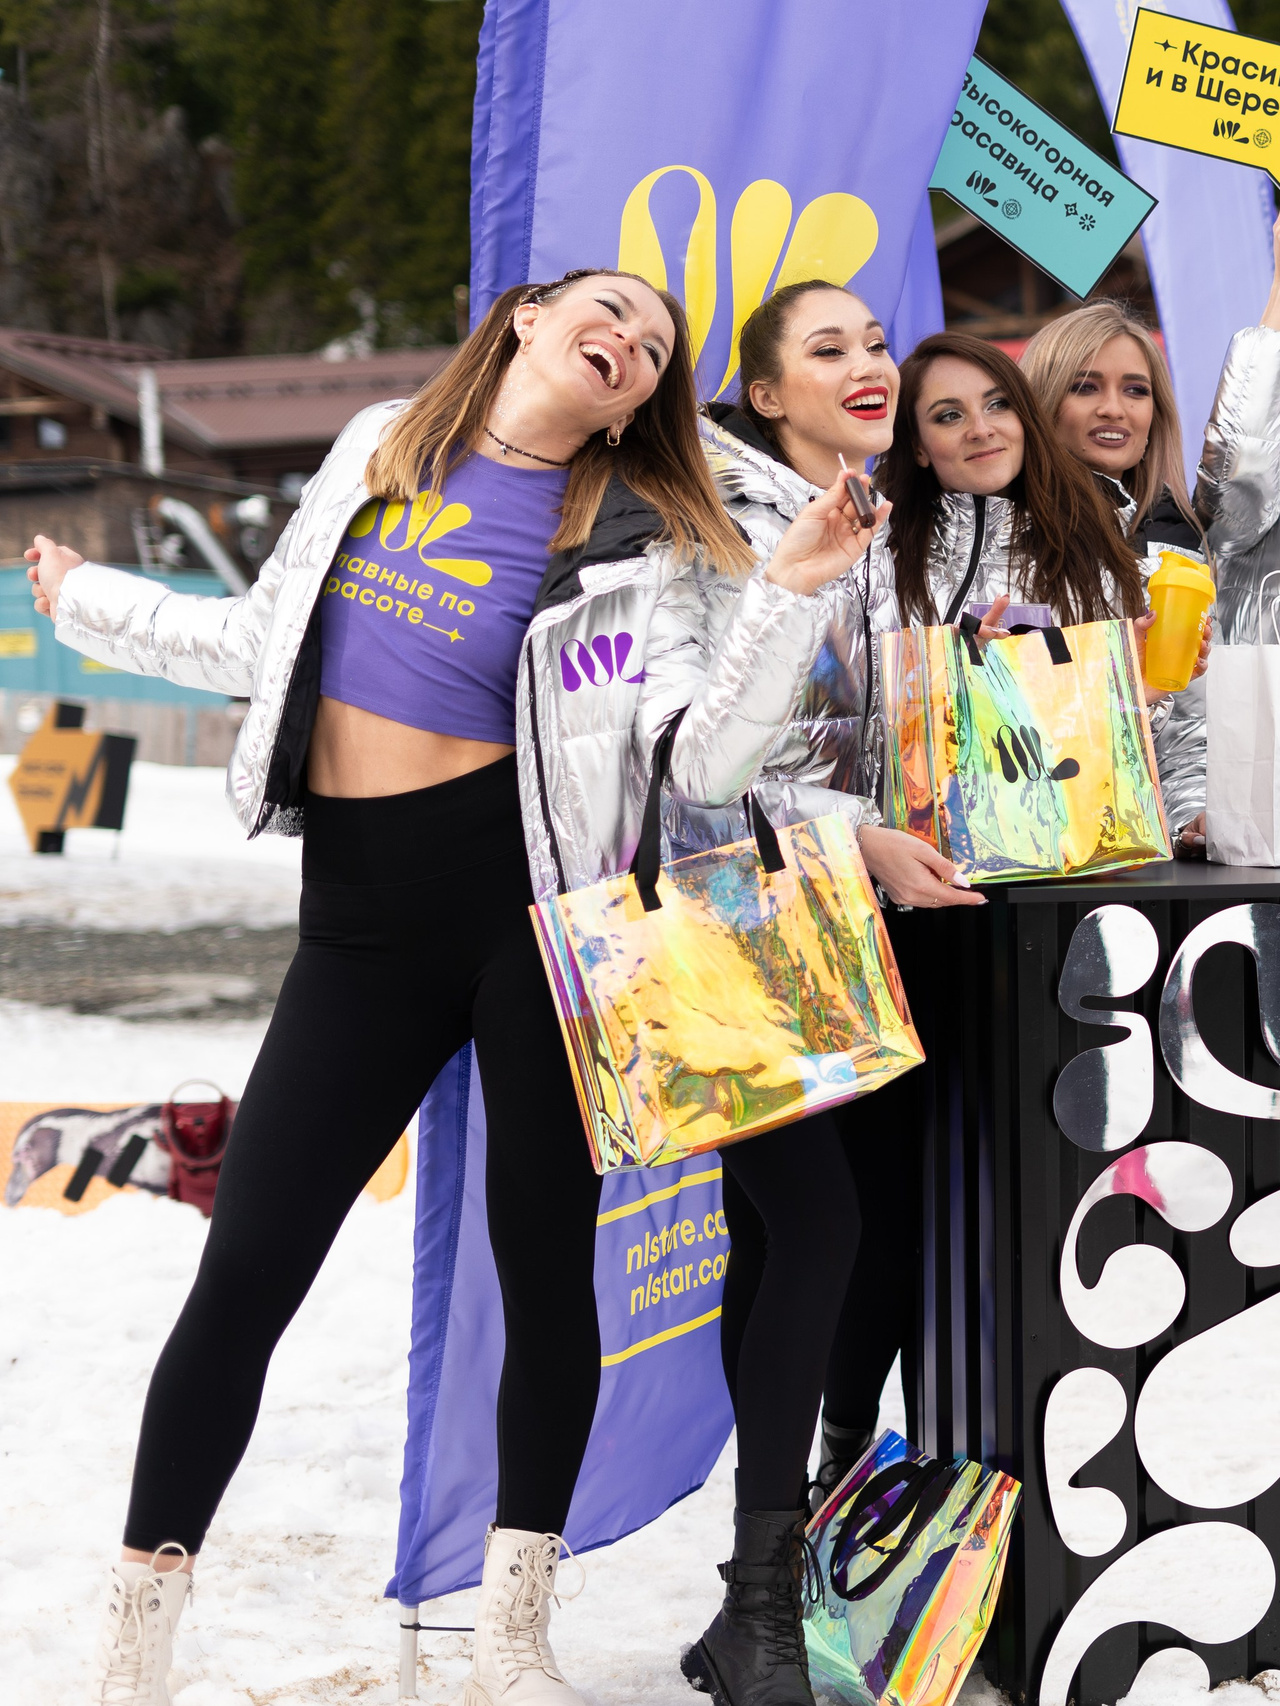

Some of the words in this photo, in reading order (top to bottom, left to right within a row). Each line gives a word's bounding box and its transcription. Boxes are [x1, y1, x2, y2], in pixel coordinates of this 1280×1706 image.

[1146, 67, 1163, 87] и
[1171, 74, 1187, 93] в
[951, 110, 1059, 202] расавица
[323, 576, 424, 623] расоте
[336, 553, 434, 598] лавные
[439, 592, 476, 616] по
[626, 1209, 729, 1274] nlstore.co
